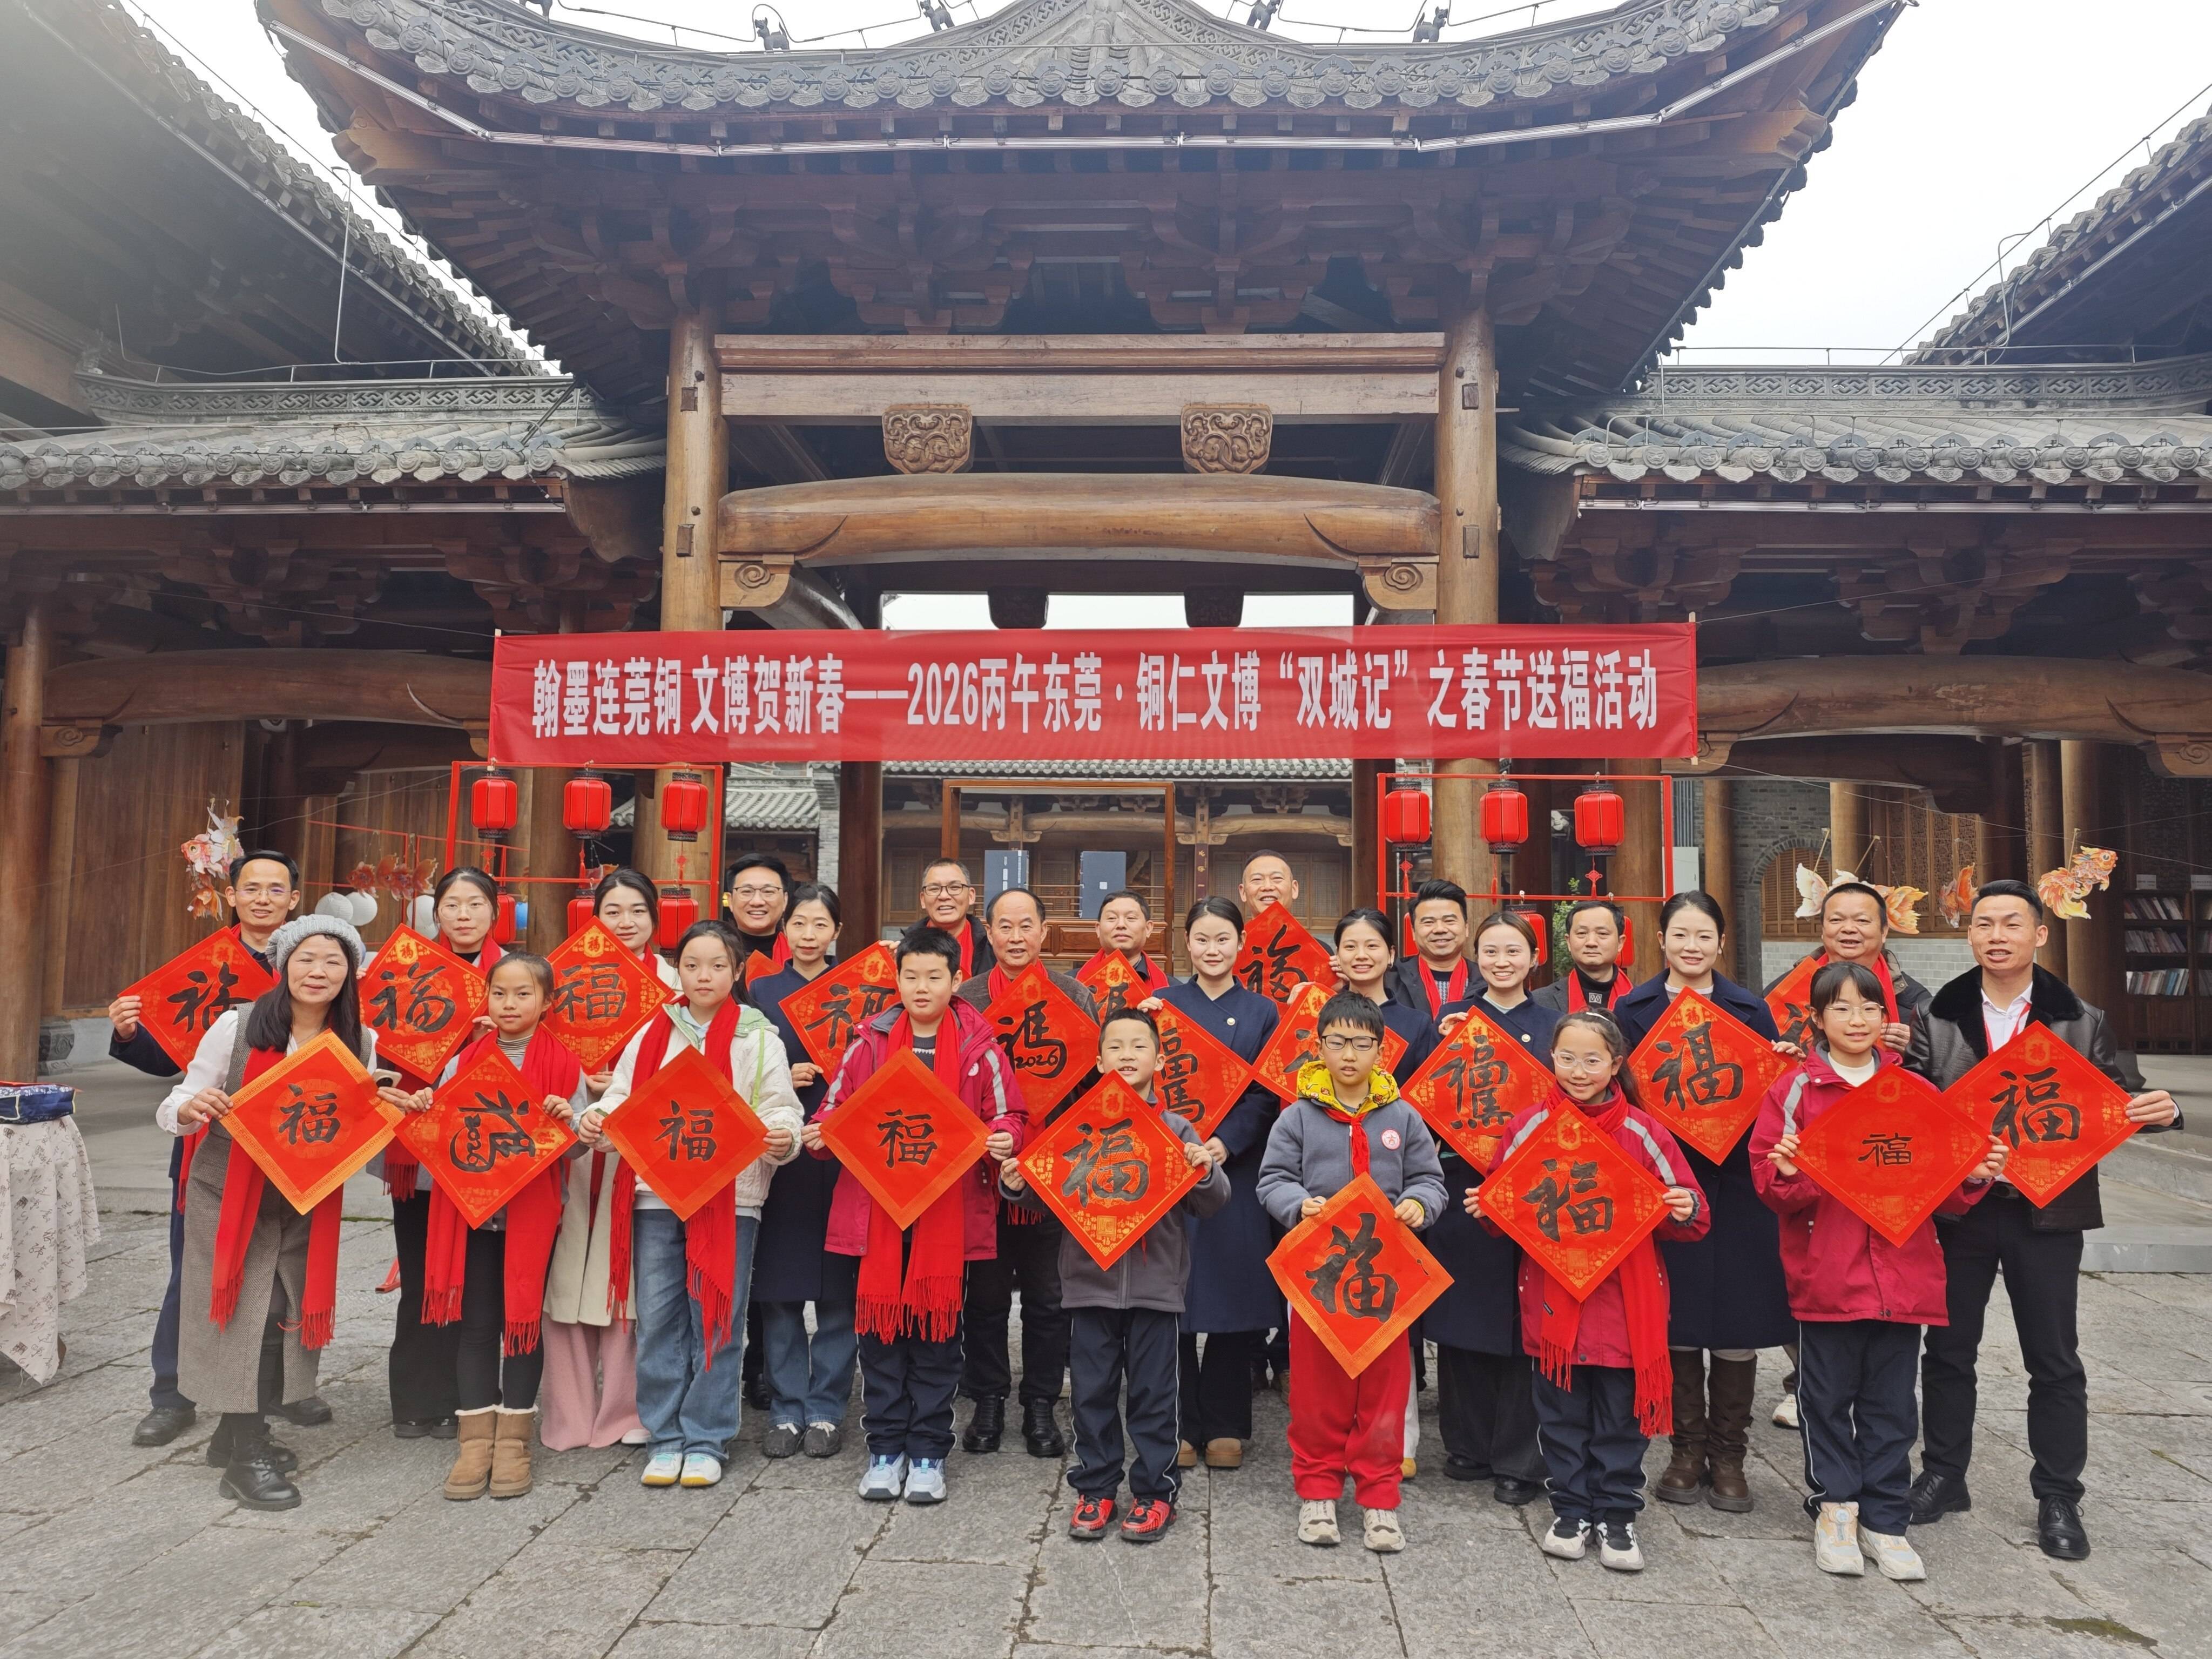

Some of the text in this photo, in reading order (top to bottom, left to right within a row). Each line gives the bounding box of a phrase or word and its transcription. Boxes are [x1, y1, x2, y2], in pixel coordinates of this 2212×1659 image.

[532, 656, 682, 738] 翰墨连莞铜
[369, 962, 456, 1033] 福
[552, 963, 626, 1023] 福
[1651, 1021, 1744, 1111] 福
[279, 1084, 341, 1145] 福
[653, 1100, 717, 1162] 福
[876, 1109, 939, 1169] 福
[1990, 1067, 2080, 1151] 福
[1061, 1117, 1149, 1209] 福
[1858, 1132, 1913, 1167] 福
[1521, 1158, 1614, 1243] 福
[1304, 1212, 1400, 1323] 福
